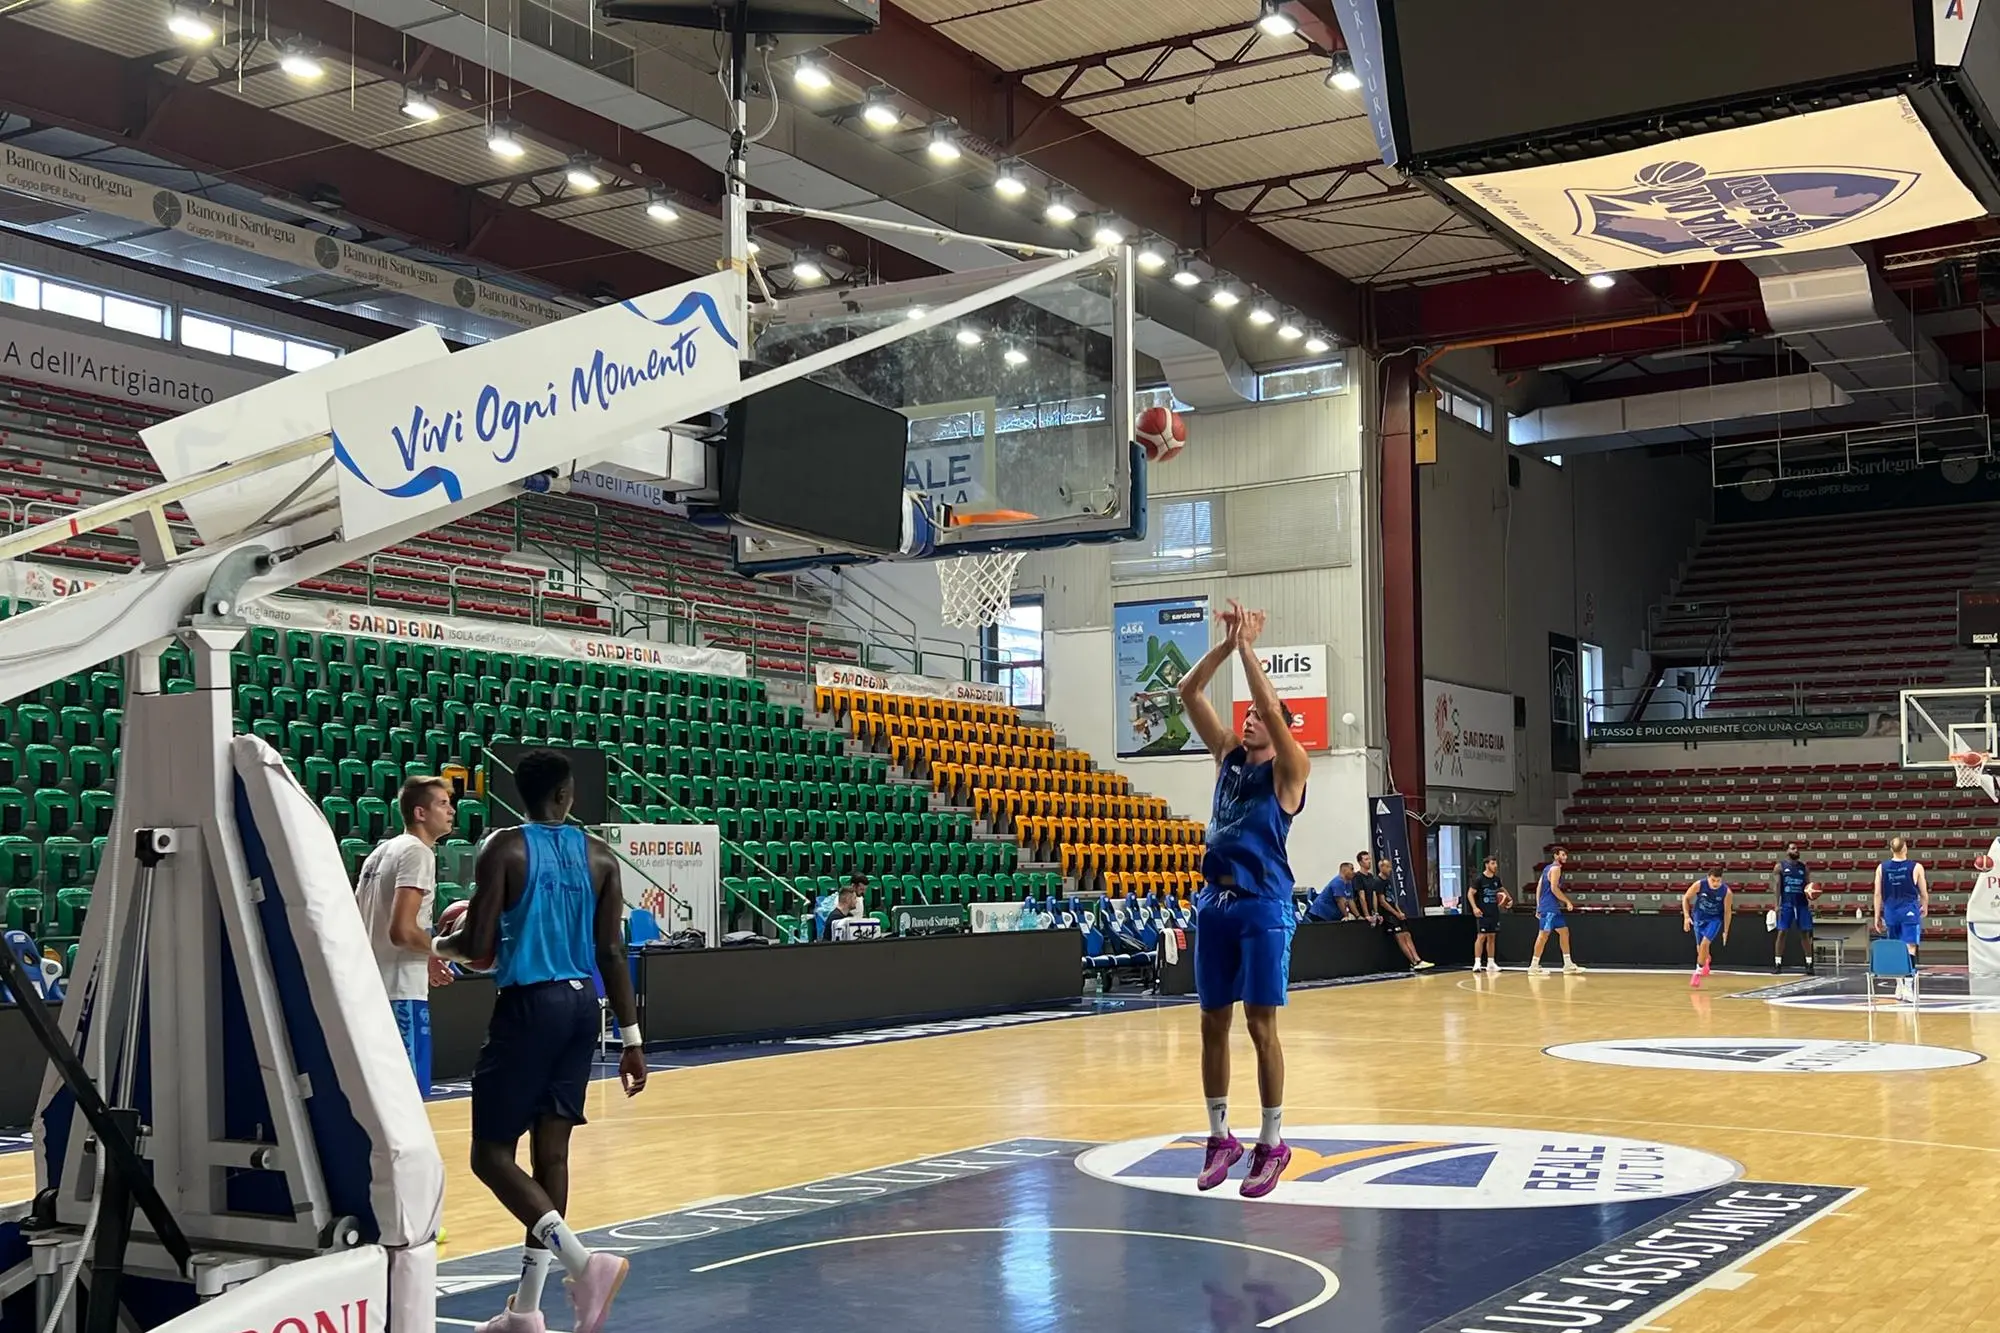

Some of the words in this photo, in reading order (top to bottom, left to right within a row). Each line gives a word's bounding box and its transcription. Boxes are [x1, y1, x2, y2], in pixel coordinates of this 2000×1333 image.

[6, 149, 51, 175] Banco
[53, 164, 66, 181] di
[68, 167, 132, 199] Sardegna
[6, 173, 40, 193] Gruppo
[40, 183, 60, 196] BPER
[61, 187, 86, 203] Banca
[186, 200, 225, 223] Banco
[226, 213, 238, 228] di
[240, 215, 296, 244] Sardegna
[187, 221, 214, 239] Gruppo
[343, 244, 377, 265] Banco
[376, 256, 388, 270] di
[389, 257, 438, 284] Sardegna
[478, 284, 509, 305] Banco
[508, 294, 518, 308] di
[519, 297, 561, 321] Sardegna
[30, 346, 214, 404] dell'Artigianato
[391, 405, 463, 471] Vivi
[475, 384, 557, 463] Ogni
[571, 326, 701, 412] Momento
[349, 613, 444, 640] SARDEGNA
[1120, 625, 1144, 634] CASA
[586, 642, 662, 665] SARDEGNA
[833, 671, 890, 691] SARDEGNA
[957, 686, 1004, 704] SARDEGNA
[1463, 730, 1505, 750] SARDEGNA
[1591, 728, 1600, 737] IL
[1601, 728, 1633, 737] TASSO
[1645, 724, 1662, 735] PIÙ
[1665, 724, 1739, 735] CONVENIENTE
[1742, 723, 1767, 733] CON
[1769, 722, 1792, 731] UNA
[1794, 721, 1824, 731] CASA
[1827, 720, 1864, 730] GREEN
[630, 841, 703, 856] SARDEGNA
[1394, 849, 1406, 897] ITALIA
[934, 915, 960, 928] Sardegna
[1523, 1144, 1606, 1191] REALE
[1614, 1146, 1665, 1193] MUTUA
[1559, 1190, 1820, 1296] ASSISTANCE
